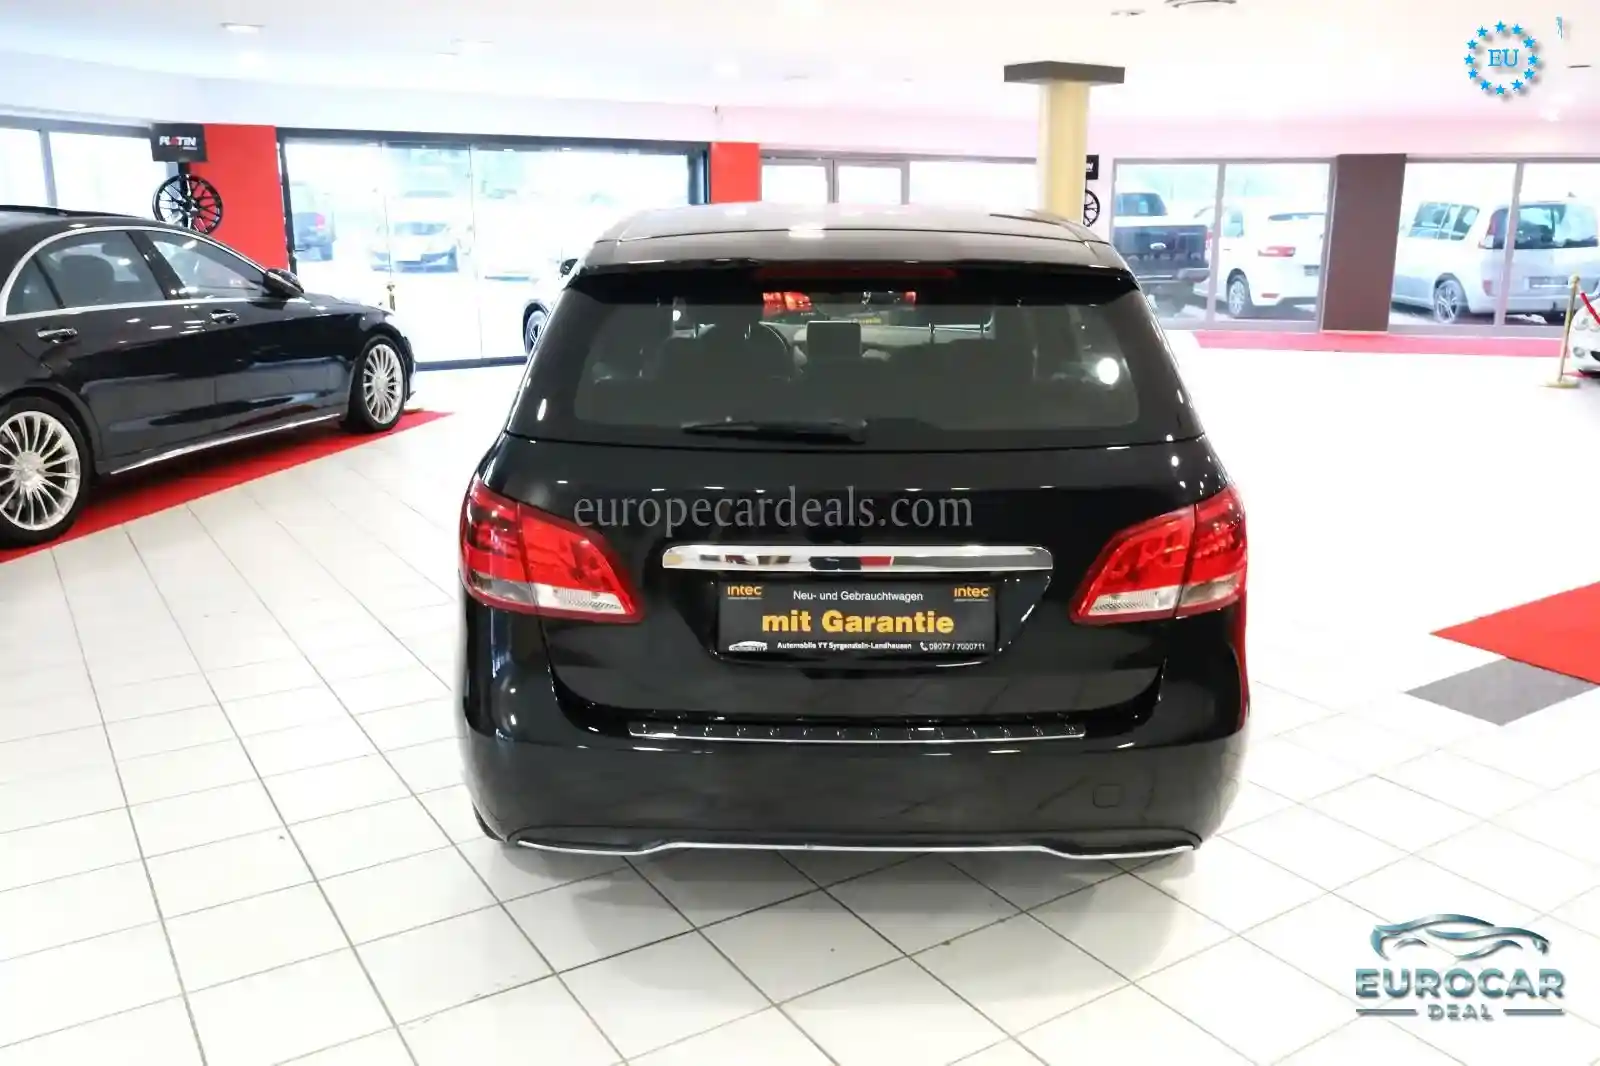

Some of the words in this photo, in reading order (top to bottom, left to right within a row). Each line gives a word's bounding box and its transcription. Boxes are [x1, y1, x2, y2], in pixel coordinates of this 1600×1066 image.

[727, 585, 762, 596] intec
[793, 590, 817, 600] Neu-
[819, 590, 838, 600] und
[840, 590, 924, 603] Gebrauchtwagen
[953, 586, 990, 598] intec
[762, 609, 812, 632] mit
[821, 610, 954, 633] Garantie
